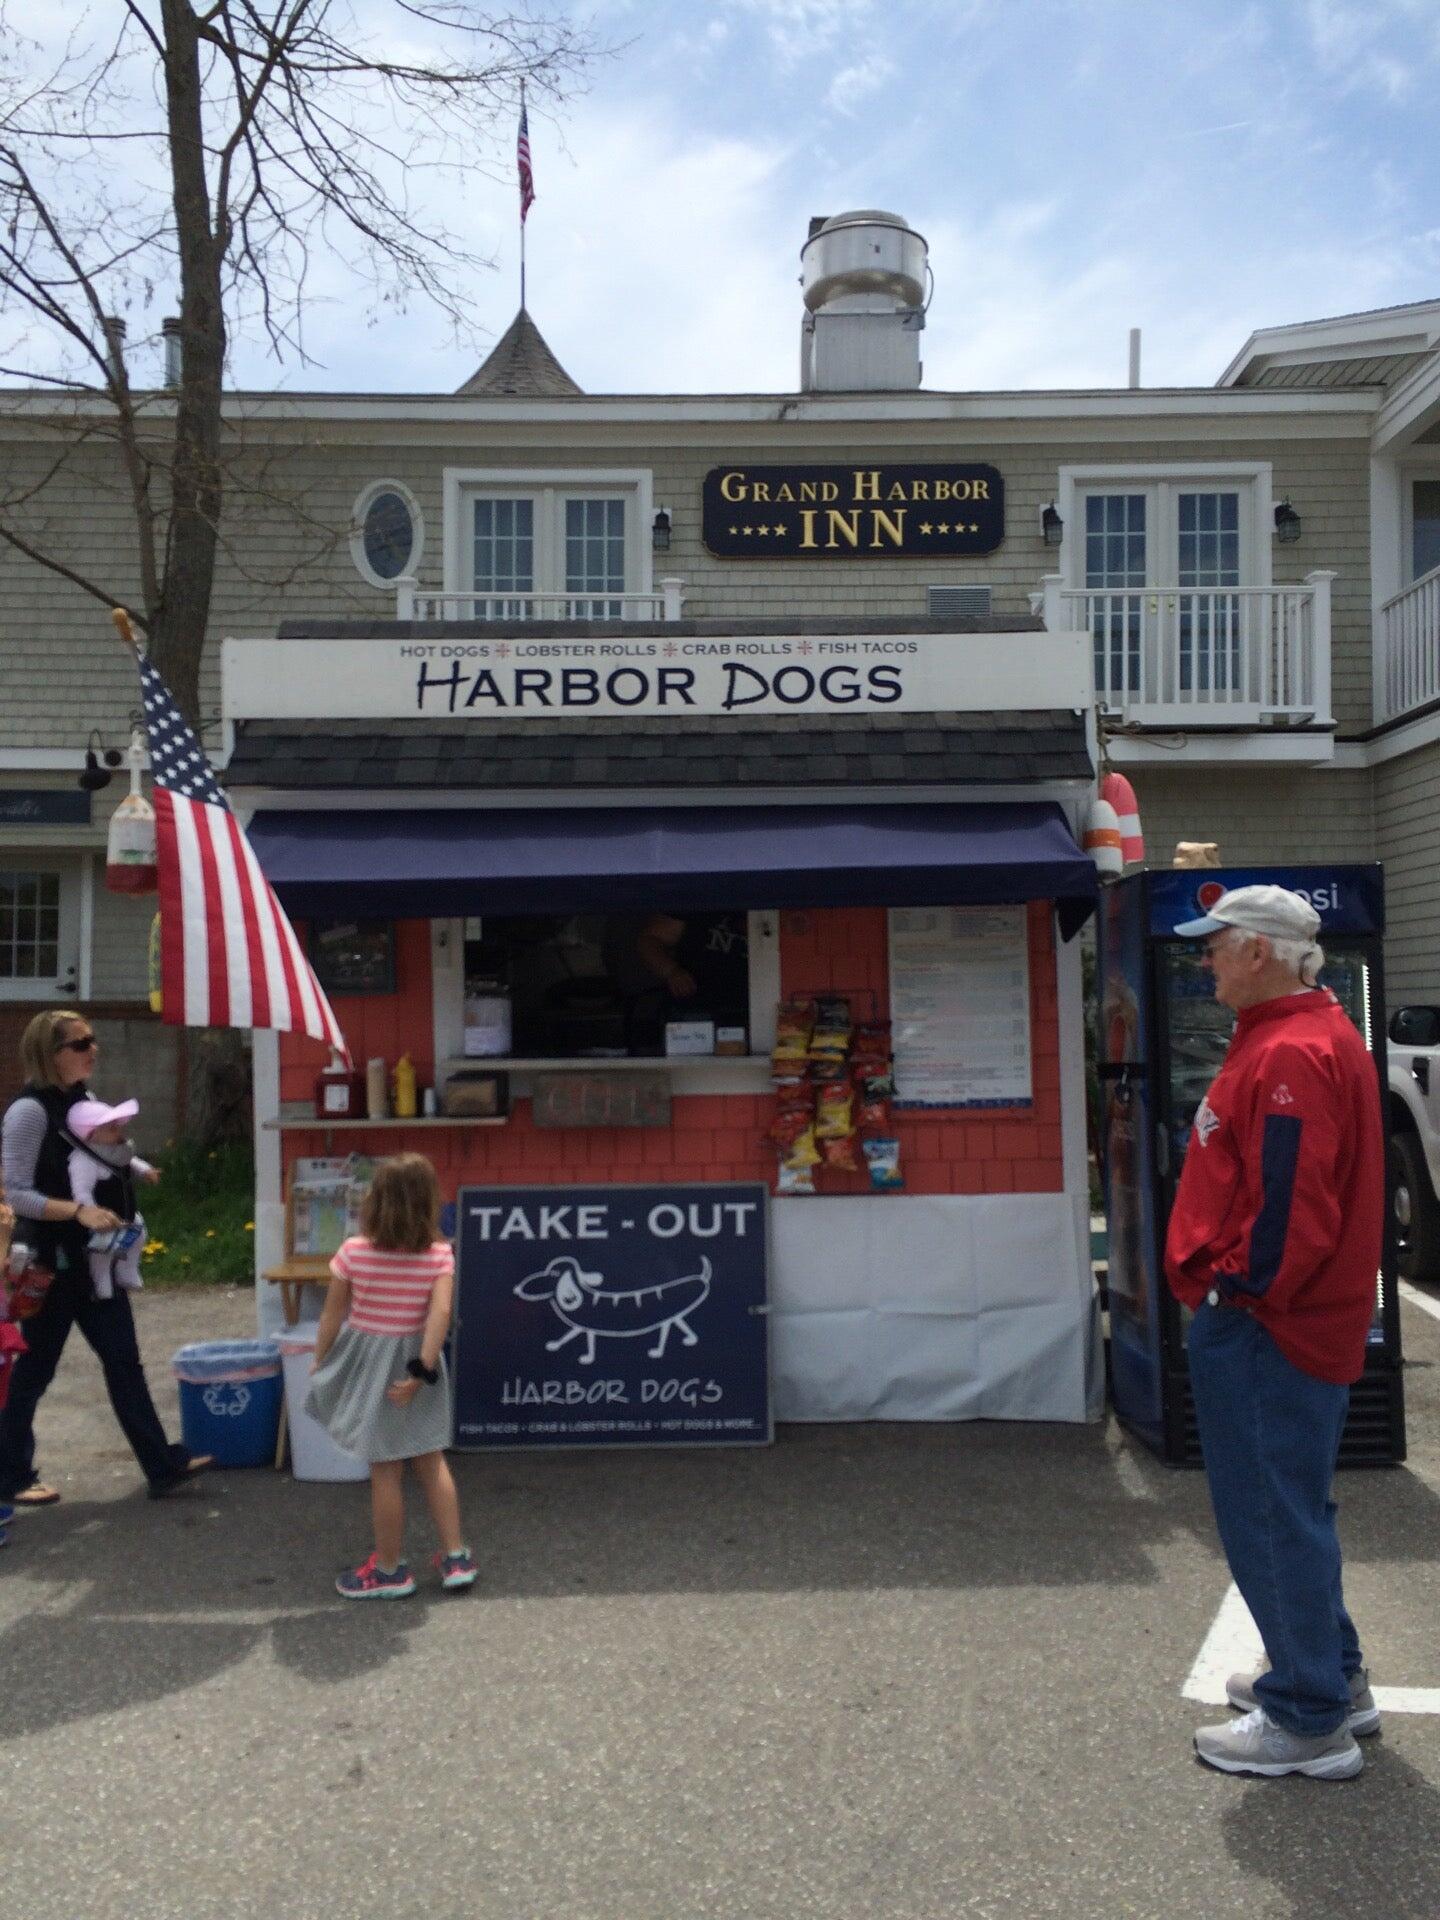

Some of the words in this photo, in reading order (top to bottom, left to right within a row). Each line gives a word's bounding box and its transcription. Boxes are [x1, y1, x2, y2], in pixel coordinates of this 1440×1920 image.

[720, 472, 839, 502] GRAND
[852, 471, 990, 500] HARBOR
[799, 509, 908, 548] INN
[400, 645, 436, 657] HOT
[441, 645, 490, 657] DOGS
[515, 644, 594, 657] LOBSTER
[601, 644, 657, 656] ROLLS
[682, 643, 730, 655] CRAB
[735, 643, 792, 655] ROLLS
[818, 642, 857, 654] FISH
[863, 642, 918, 654] TACOS
[417, 660, 697, 713] HARBOR
[721, 662, 903, 711] DOGS
[469, 1205, 608, 1241] TAKE
[648, 1203, 757, 1238] OUT
[503, 1376, 629, 1405] HARBOR
[640, 1378, 723, 1408] DOGS
